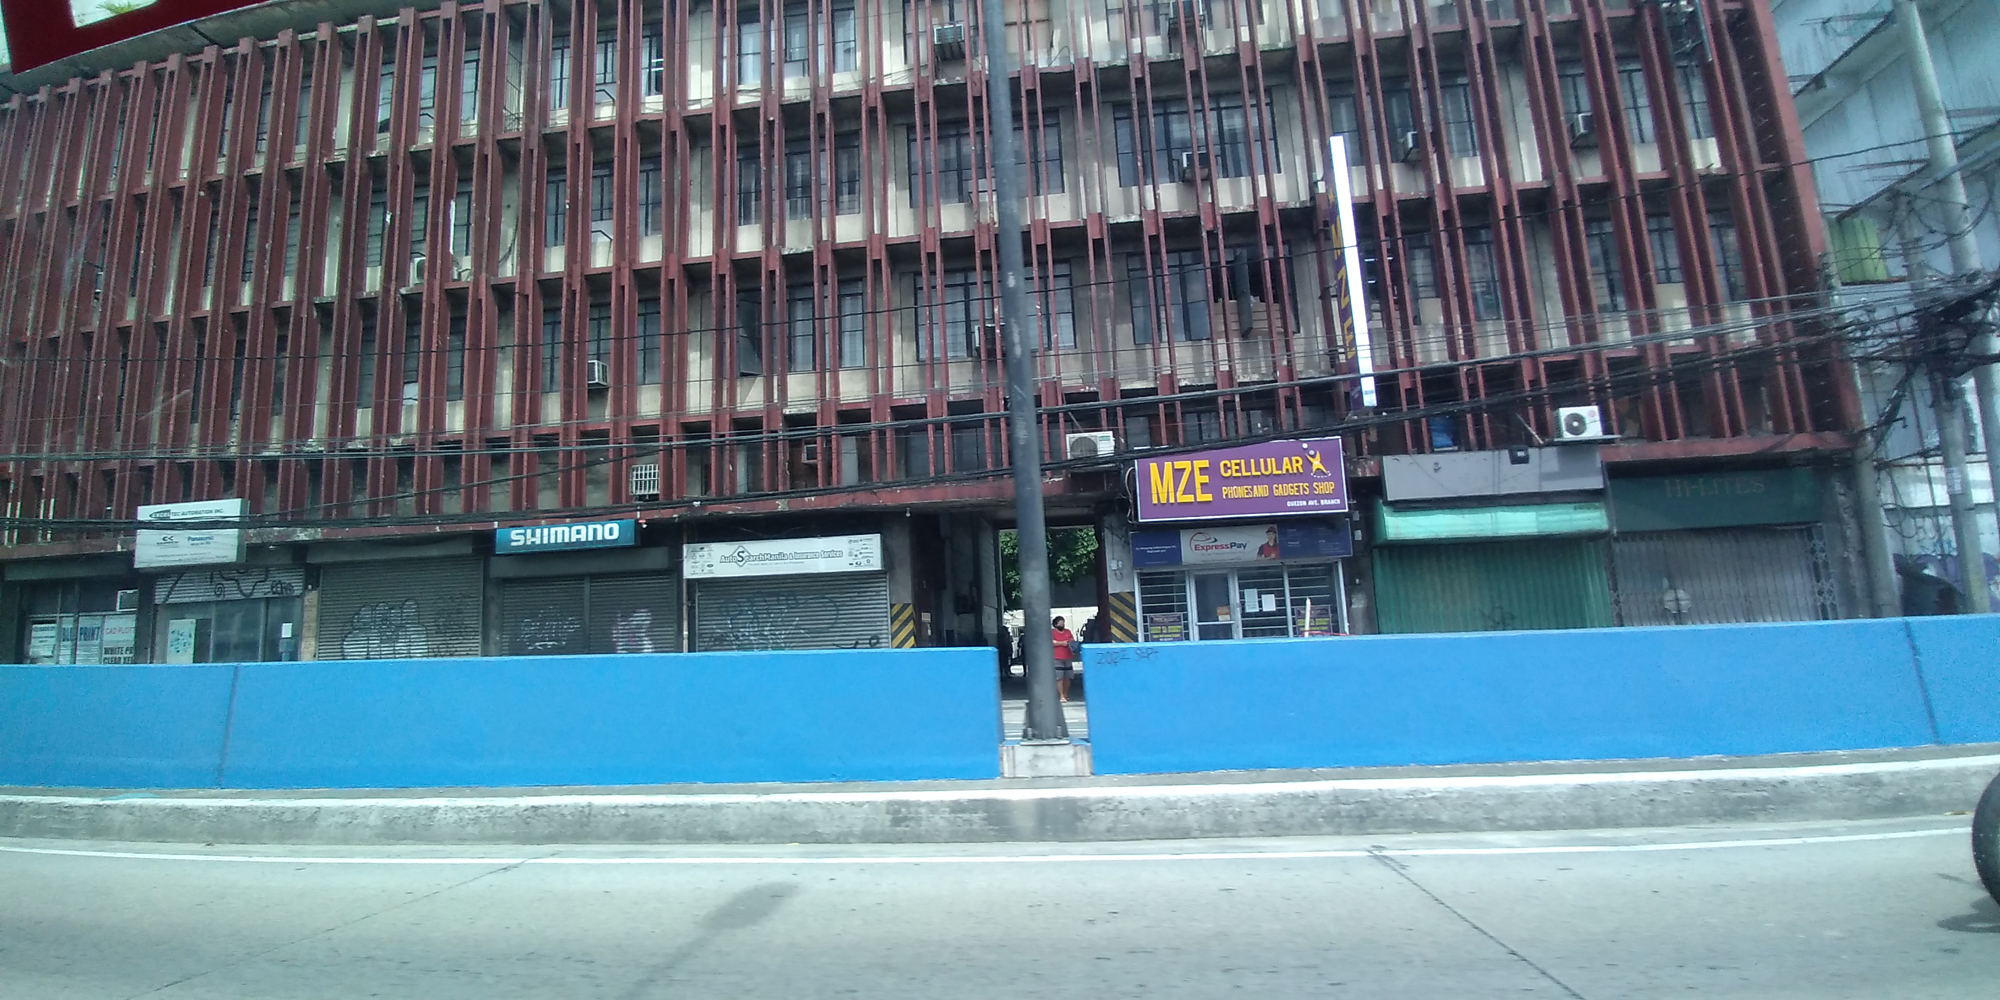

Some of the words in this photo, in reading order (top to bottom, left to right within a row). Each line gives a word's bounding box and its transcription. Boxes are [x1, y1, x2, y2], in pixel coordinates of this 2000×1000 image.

[1219, 456, 1303, 477] CELLULAR
[1150, 460, 1213, 504] MZE
[1273, 483, 1309, 496] GADGETS
[1313, 481, 1335, 494] SHOP
[510, 523, 620, 546] SHIMANO
[1194, 541, 1248, 551] ExpressPay
